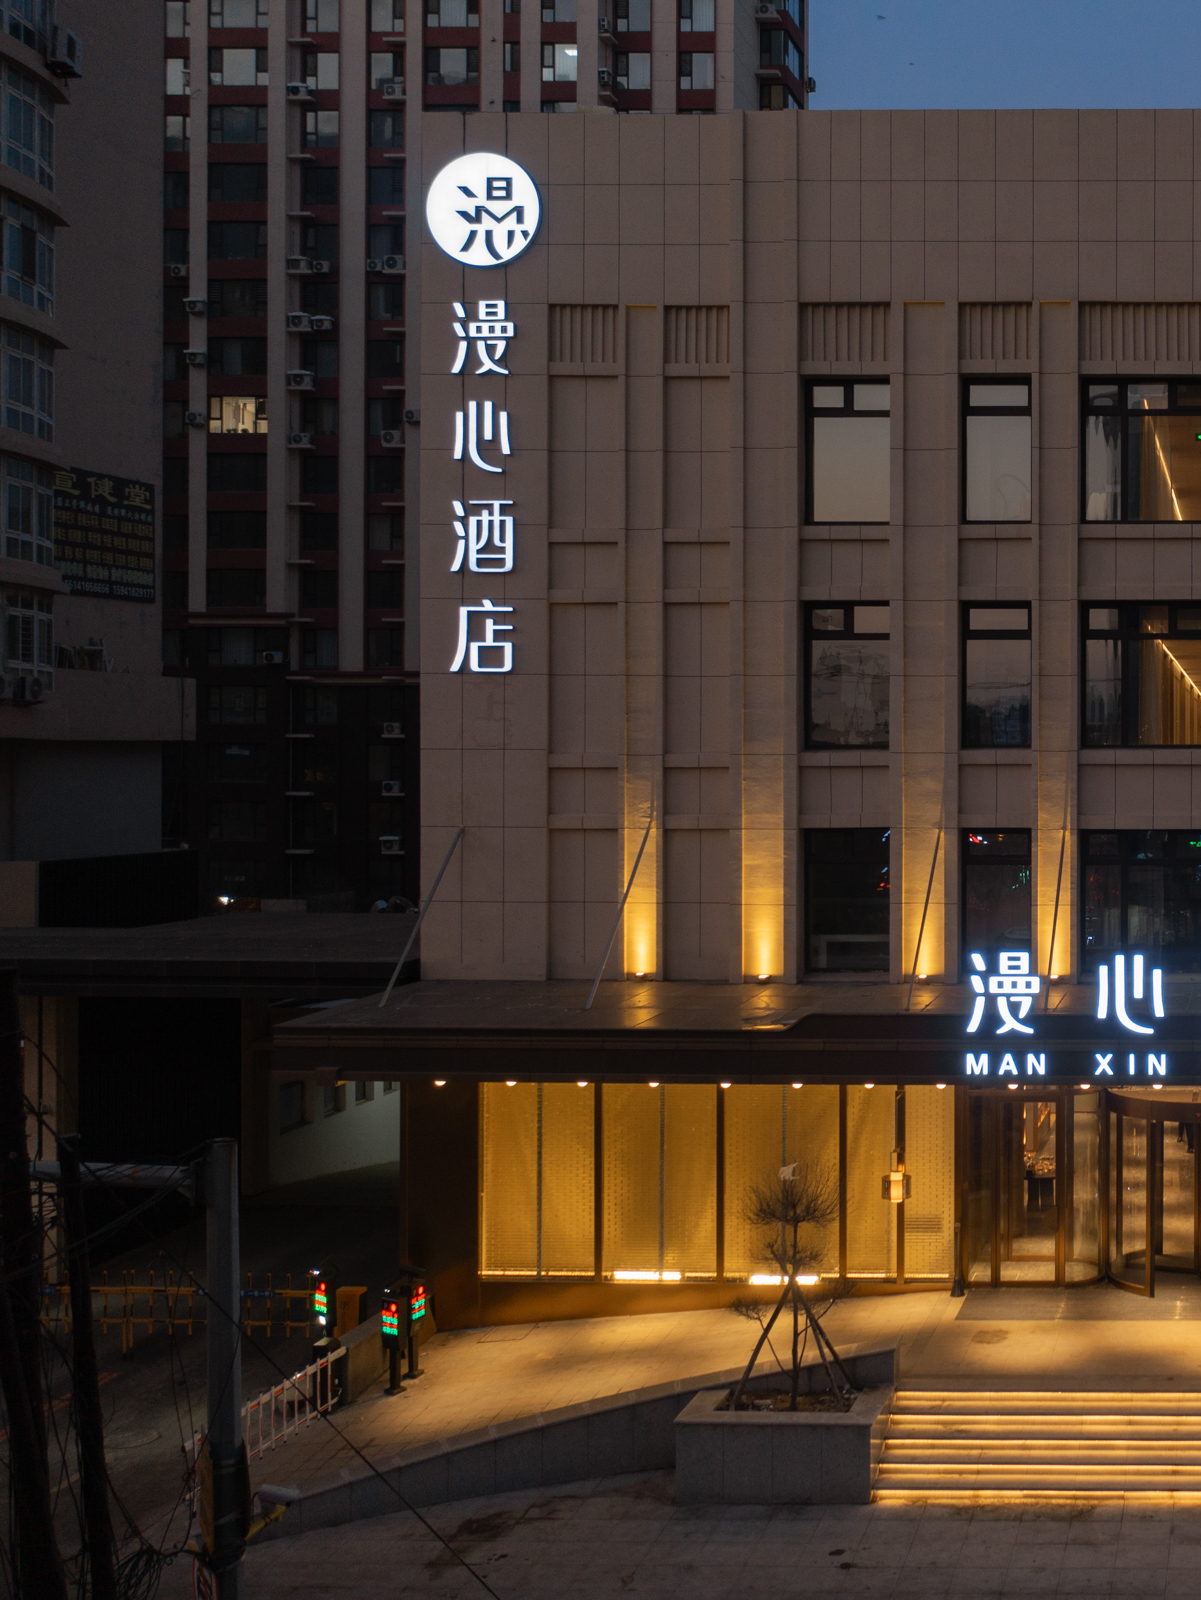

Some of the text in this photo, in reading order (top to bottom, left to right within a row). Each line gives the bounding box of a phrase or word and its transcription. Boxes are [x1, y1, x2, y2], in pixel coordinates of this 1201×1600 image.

[449, 299, 515, 673] 漫心酒店
[965, 1053, 1046, 1076] MAN
[1094, 1053, 1167, 1076] XIN
